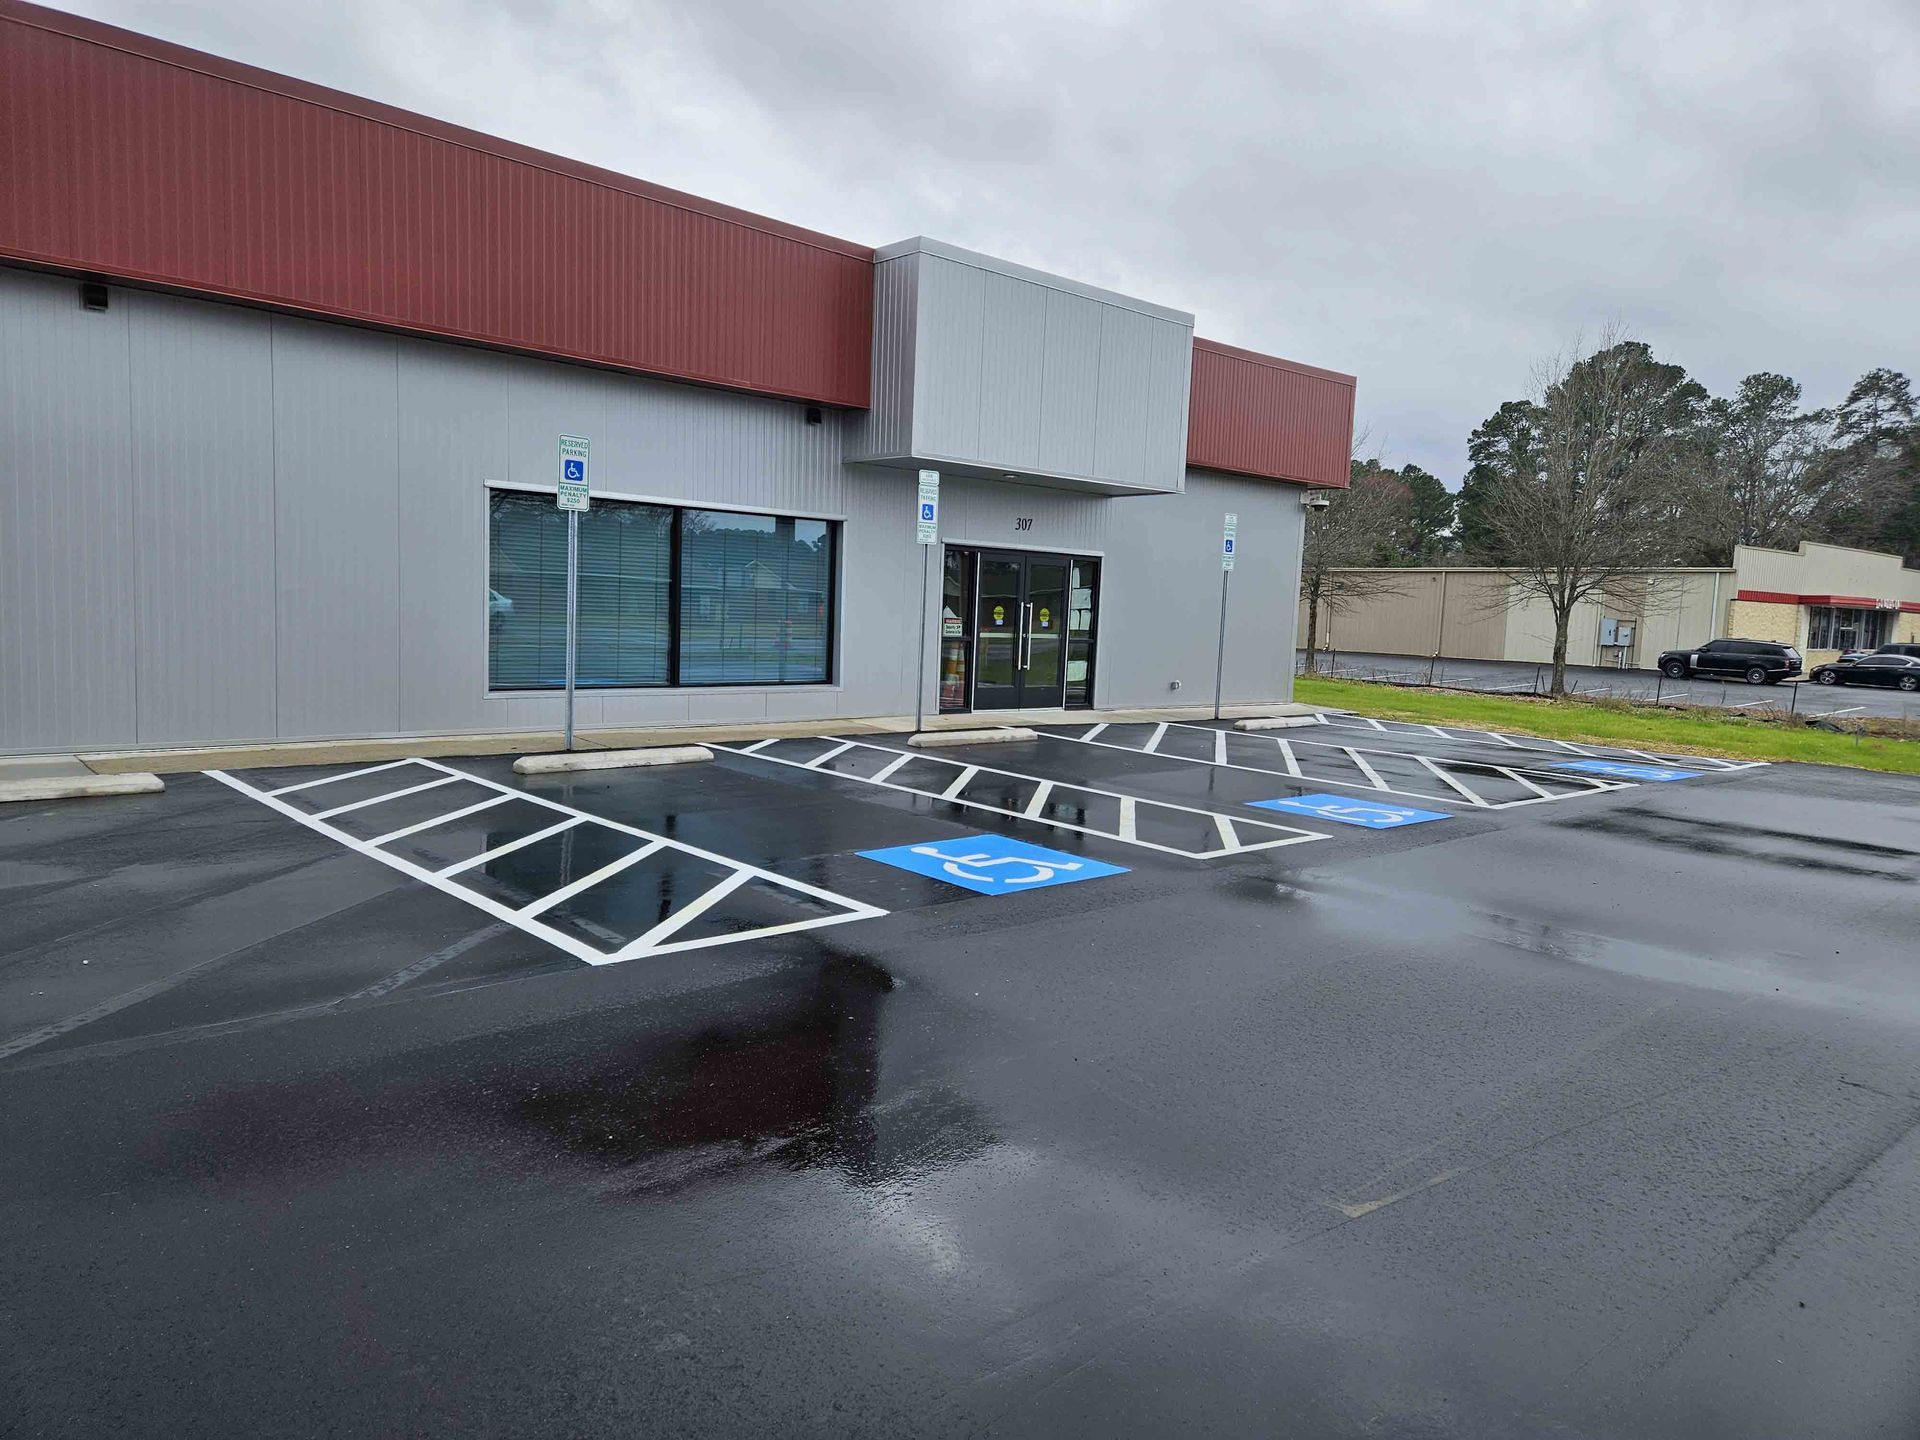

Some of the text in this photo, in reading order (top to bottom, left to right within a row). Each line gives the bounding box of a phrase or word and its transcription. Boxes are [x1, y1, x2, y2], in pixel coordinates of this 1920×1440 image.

[560, 439, 588, 449] RESERVED
[561, 447, 587, 457] PARKING
[560, 484, 588, 493] MAXIMUM
[560, 491, 587, 499] PENALTY
[1015, 517, 1033, 531] 307
